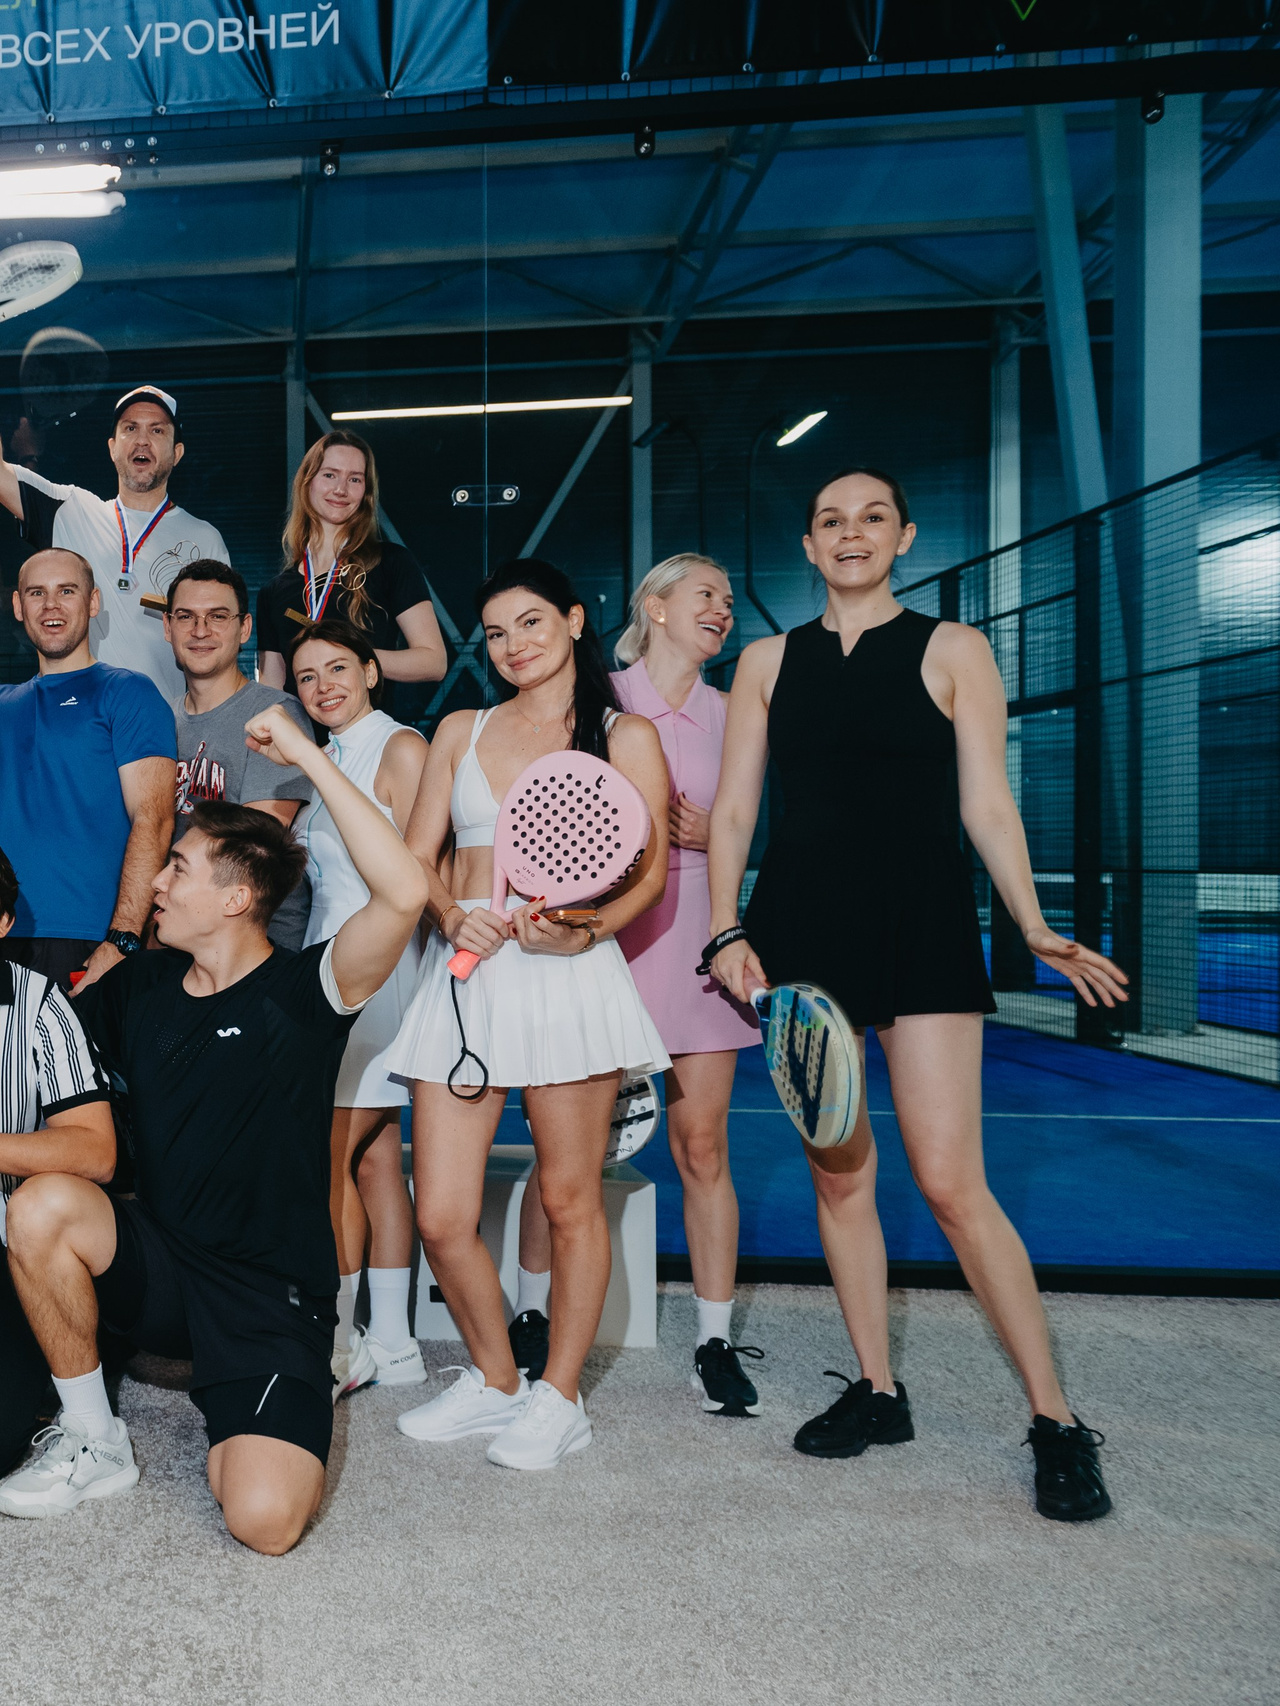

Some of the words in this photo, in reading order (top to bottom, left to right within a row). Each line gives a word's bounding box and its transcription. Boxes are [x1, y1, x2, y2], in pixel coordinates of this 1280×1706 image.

[126, 1, 341, 60] УРОВНЕЙ
[522, 865, 535, 878] UNO
[400, 1351, 418, 1363] COURT
[93, 1447, 125, 1467] HEAD
